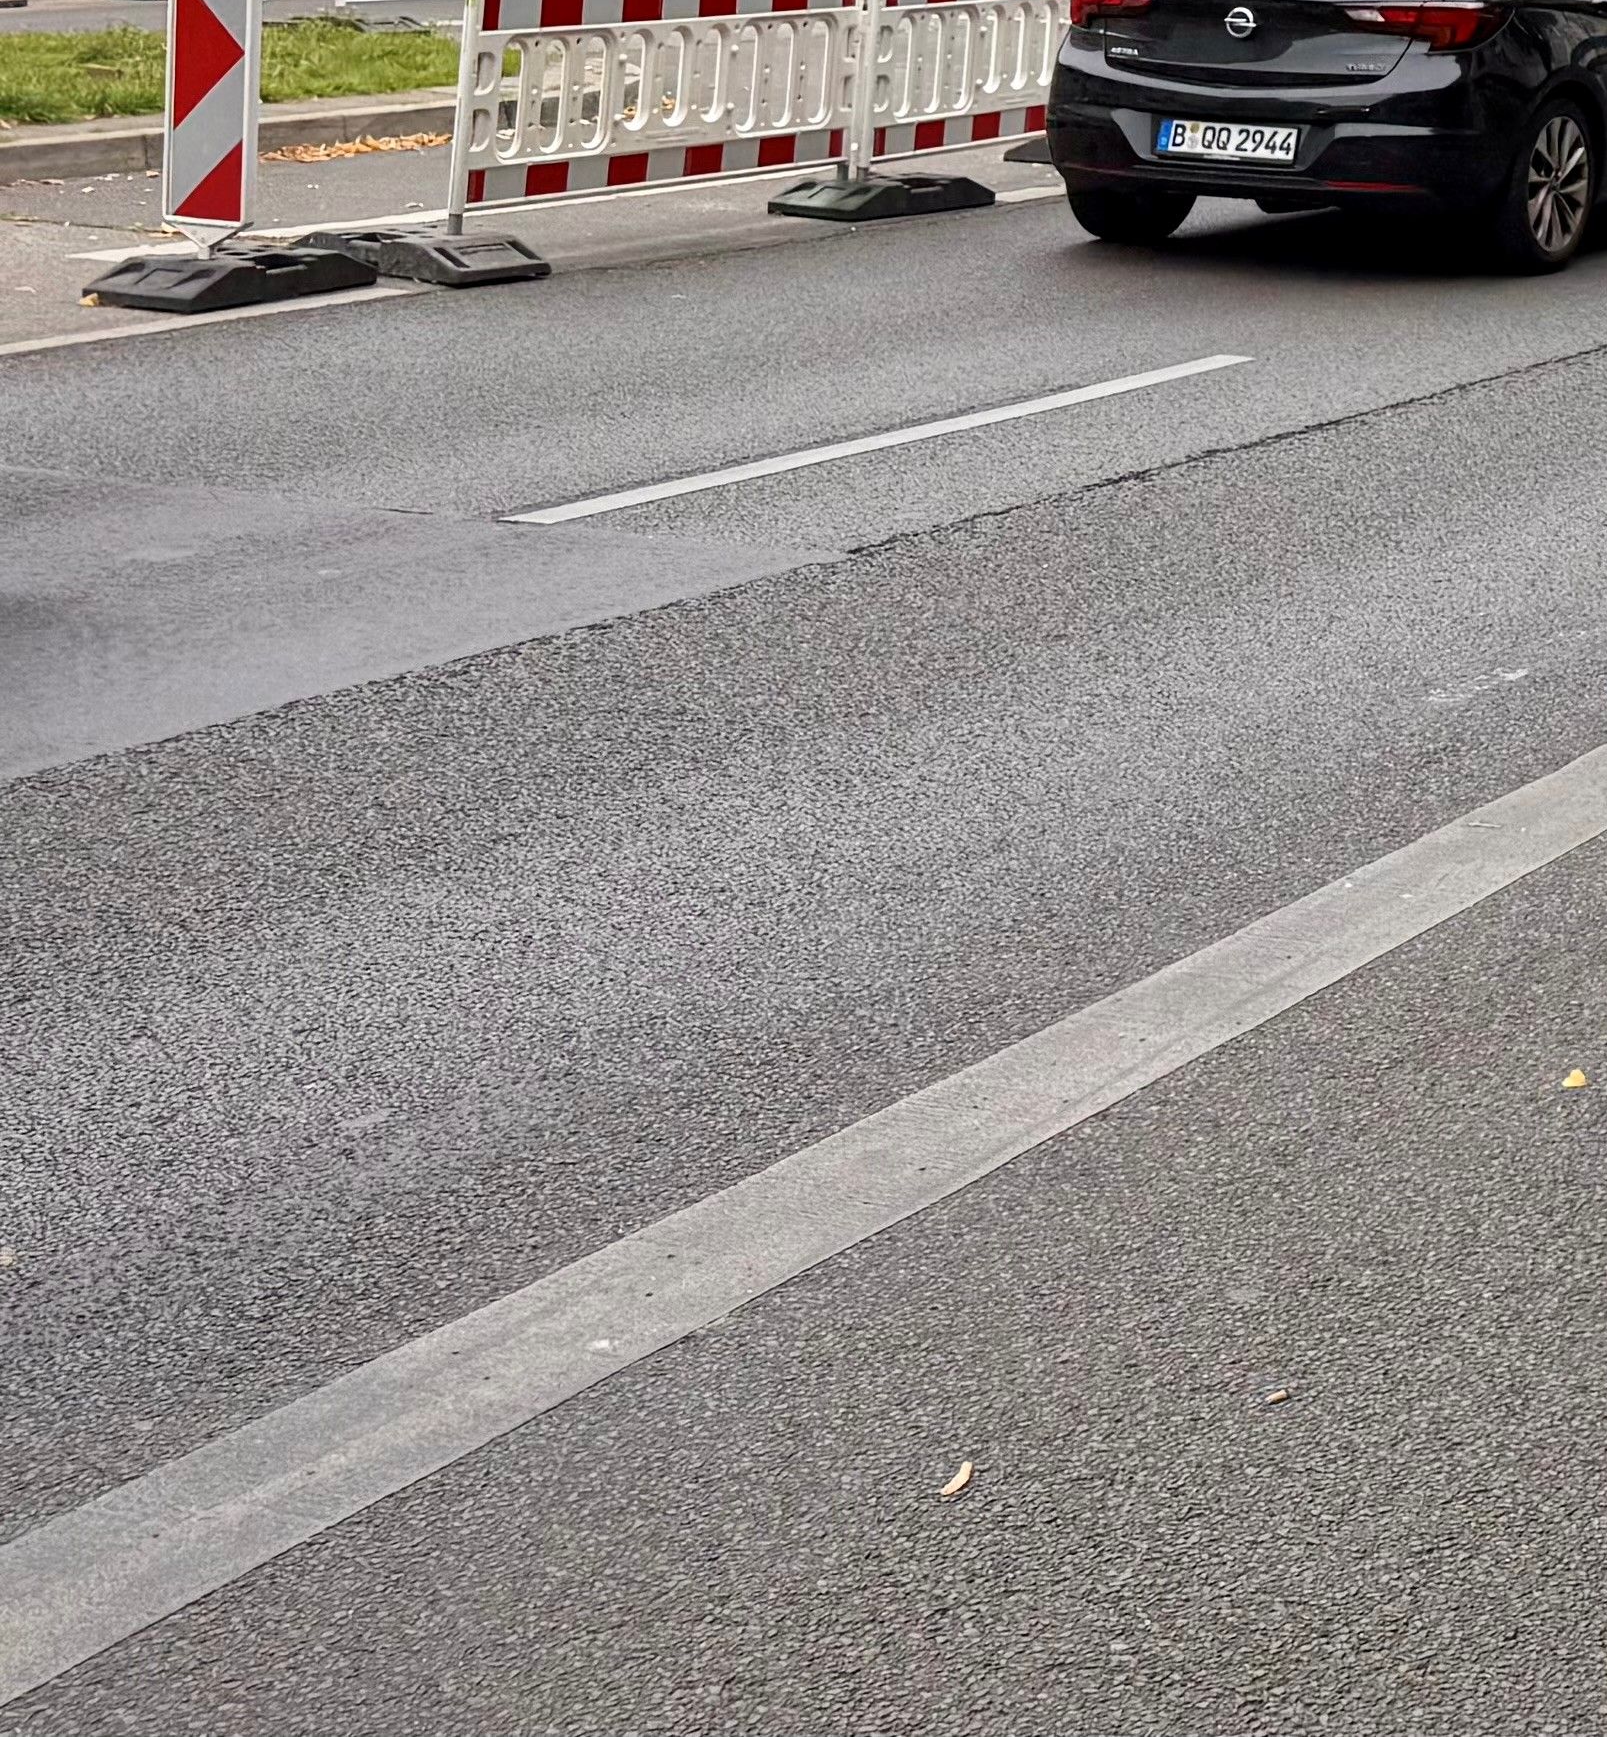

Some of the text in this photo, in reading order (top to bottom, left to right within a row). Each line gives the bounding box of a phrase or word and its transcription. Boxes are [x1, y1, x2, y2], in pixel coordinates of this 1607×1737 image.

[1172, 123, 1293, 156] B QQ 2944
